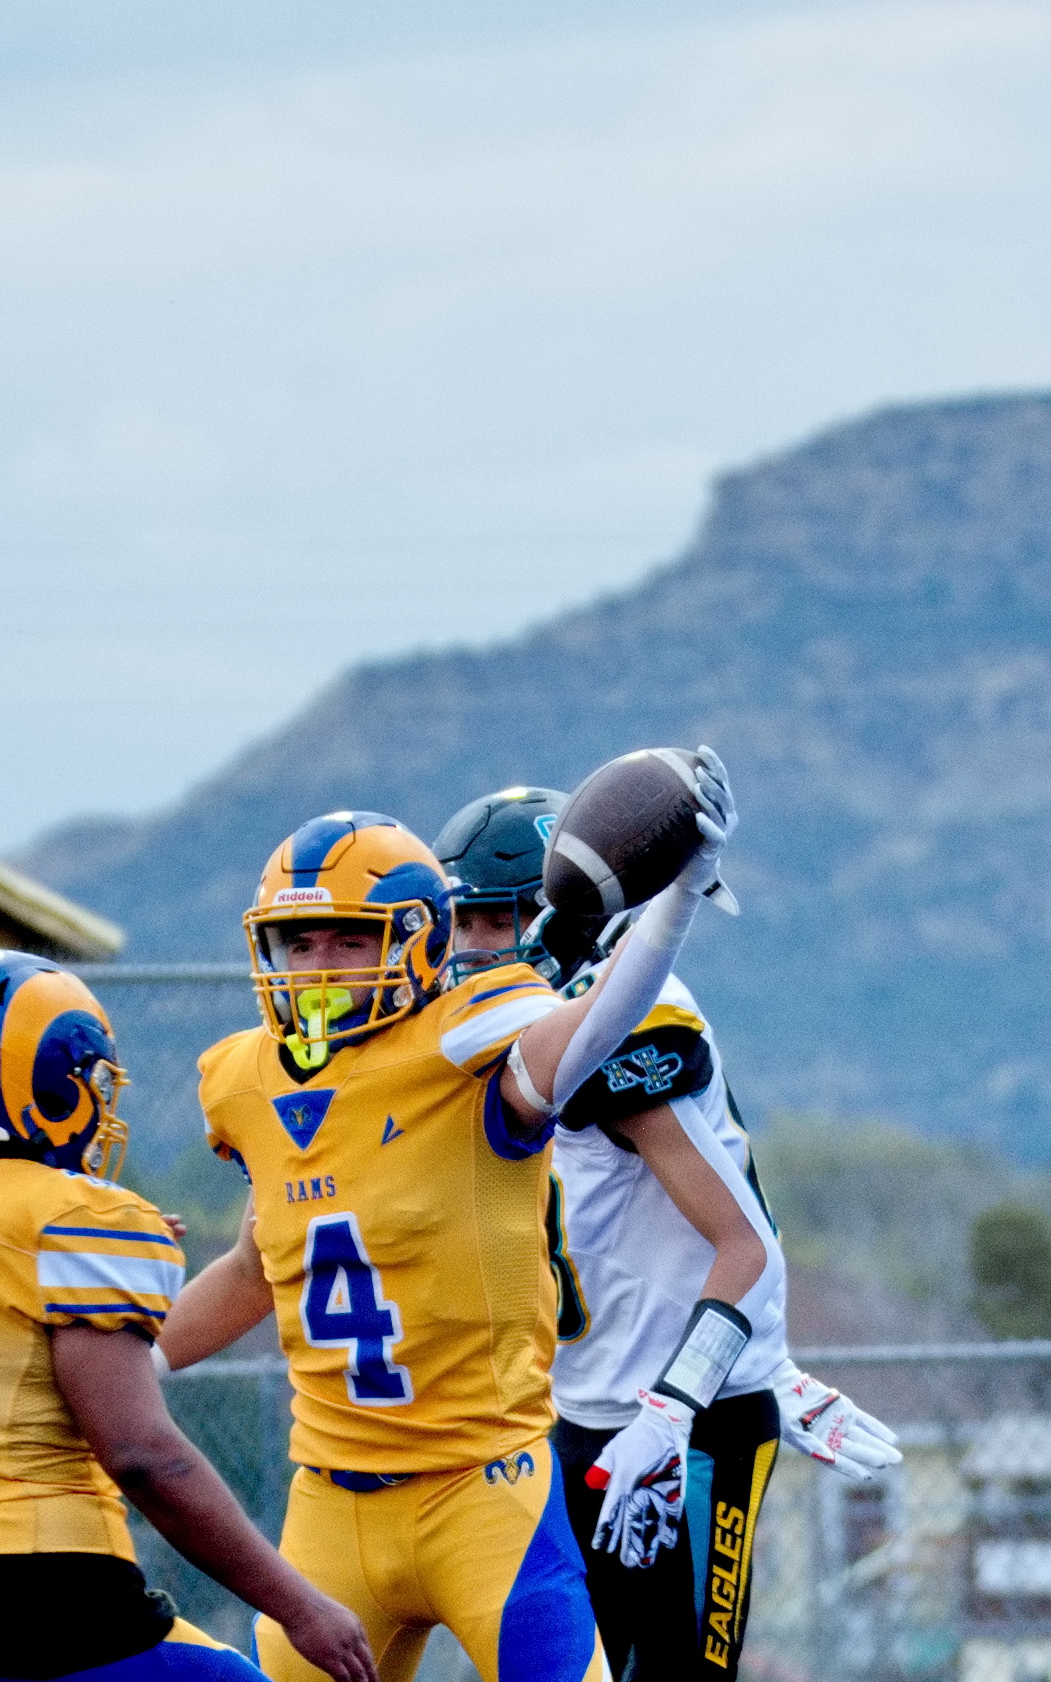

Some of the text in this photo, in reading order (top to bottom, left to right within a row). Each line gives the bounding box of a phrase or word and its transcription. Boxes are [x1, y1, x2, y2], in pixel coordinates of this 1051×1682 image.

[285, 1175, 337, 1203] RAMS
[299, 1211, 415, 1406] 4
[704, 1501, 746, 1669] EAGLES
